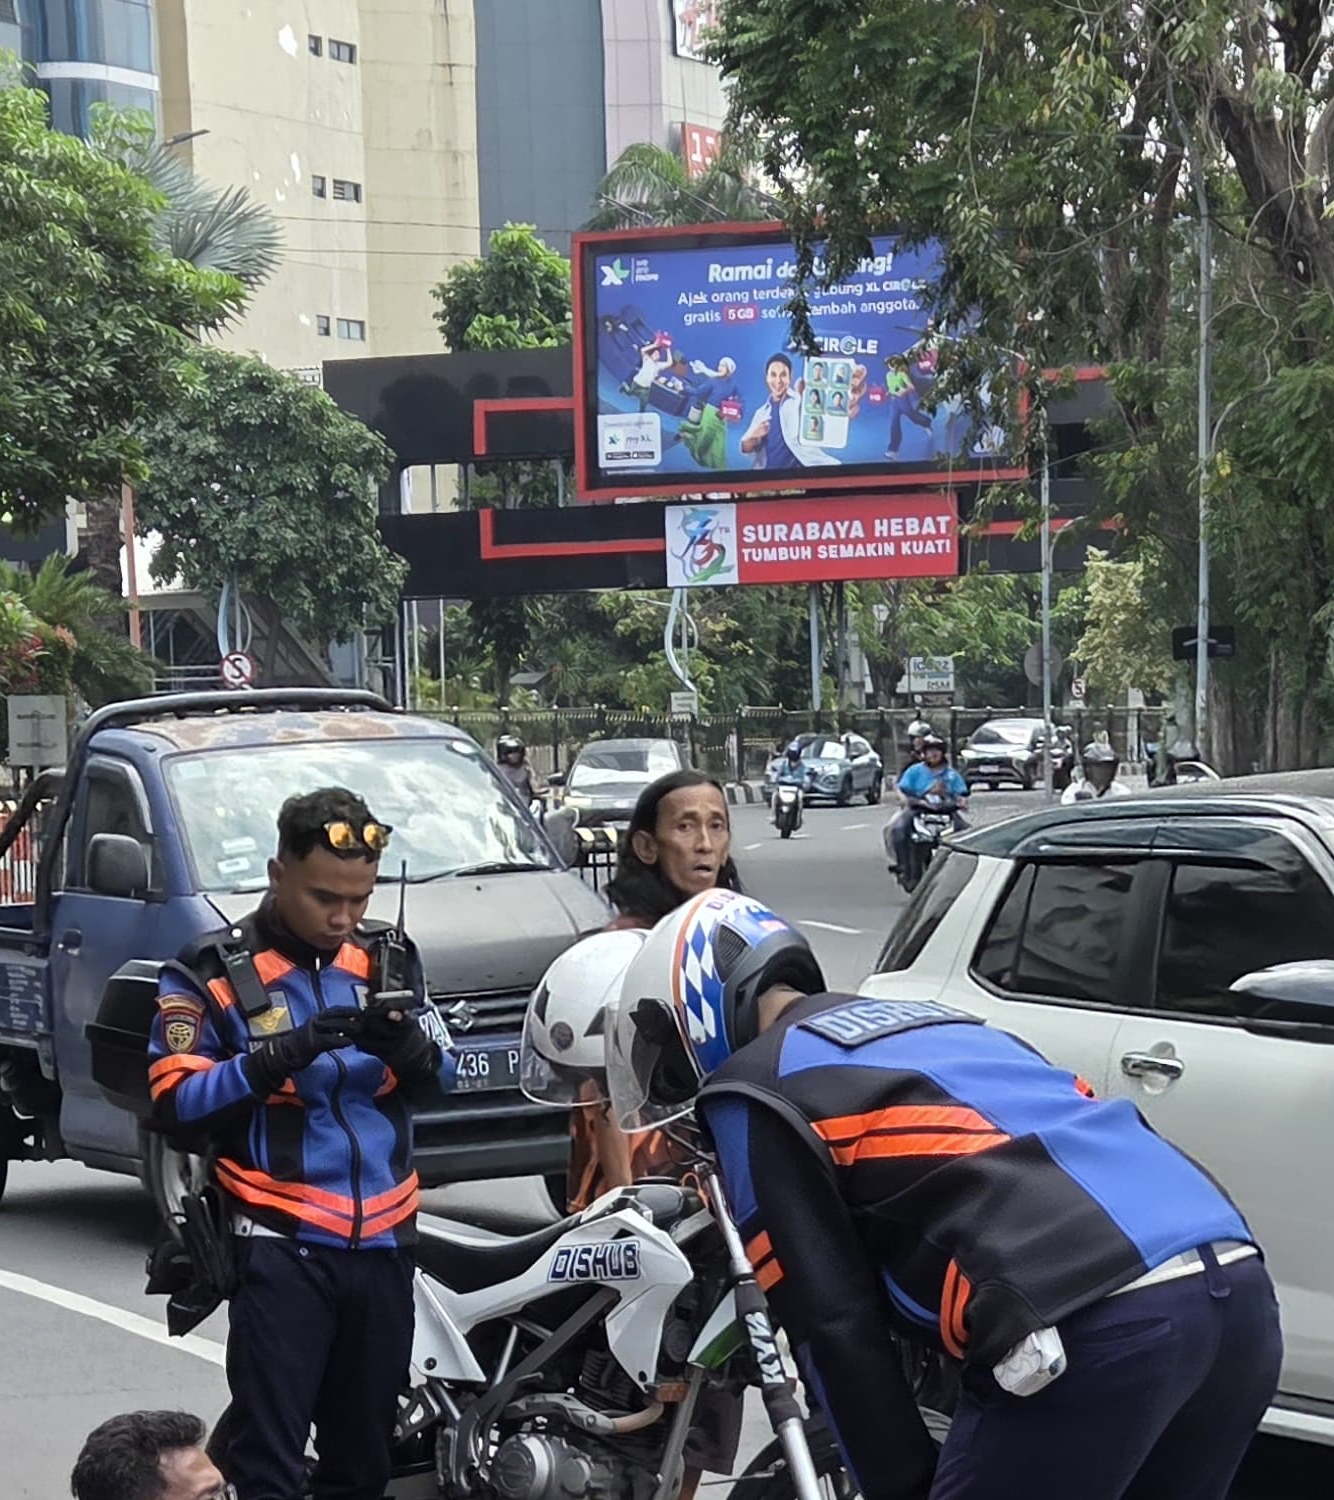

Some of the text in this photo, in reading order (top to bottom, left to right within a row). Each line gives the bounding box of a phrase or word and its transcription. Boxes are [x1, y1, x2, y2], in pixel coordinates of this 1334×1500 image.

[635, 273, 660, 282] more
[708, 258, 773, 283] Ramai
[776, 261, 809, 278] da
[711, 289, 749, 304] orang
[865, 281, 880, 292] XL
[683, 309, 721, 326] gratis
[806, 301, 856, 316] ambah
[742, 515, 951, 543] SURABAYA HEBAT
[742, 545, 812, 563] TUMBUH
[817, 542, 895, 559] SEMAKIN
[549, 1242, 639, 1281] DISHUB
